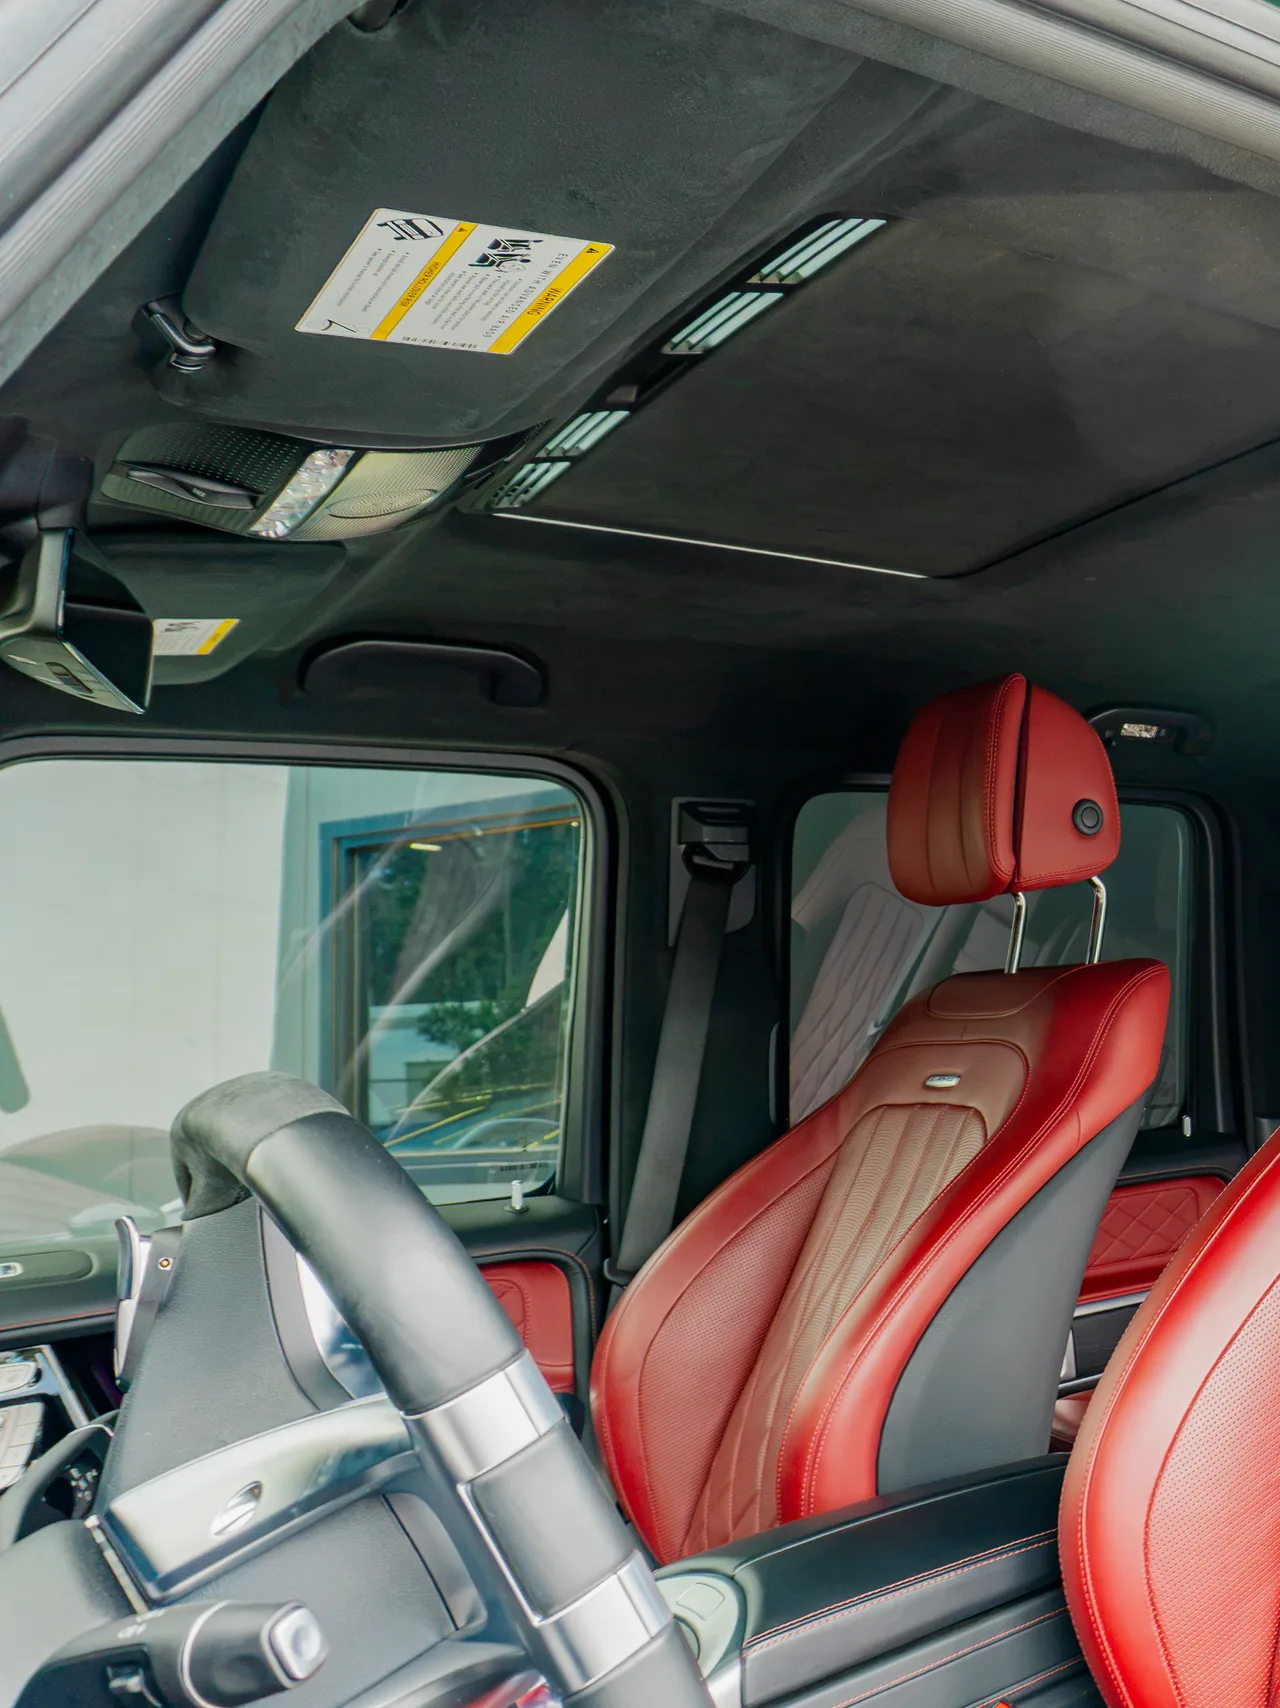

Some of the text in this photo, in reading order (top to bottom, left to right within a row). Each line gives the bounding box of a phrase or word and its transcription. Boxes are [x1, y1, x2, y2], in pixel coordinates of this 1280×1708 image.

[546, 252, 569, 268] EVEN
[531, 269, 552, 284] WITH
[504, 285, 537, 313] ADVANCED
[525, 287, 564, 316] WARNING
[494, 314, 510, 323] AIR
